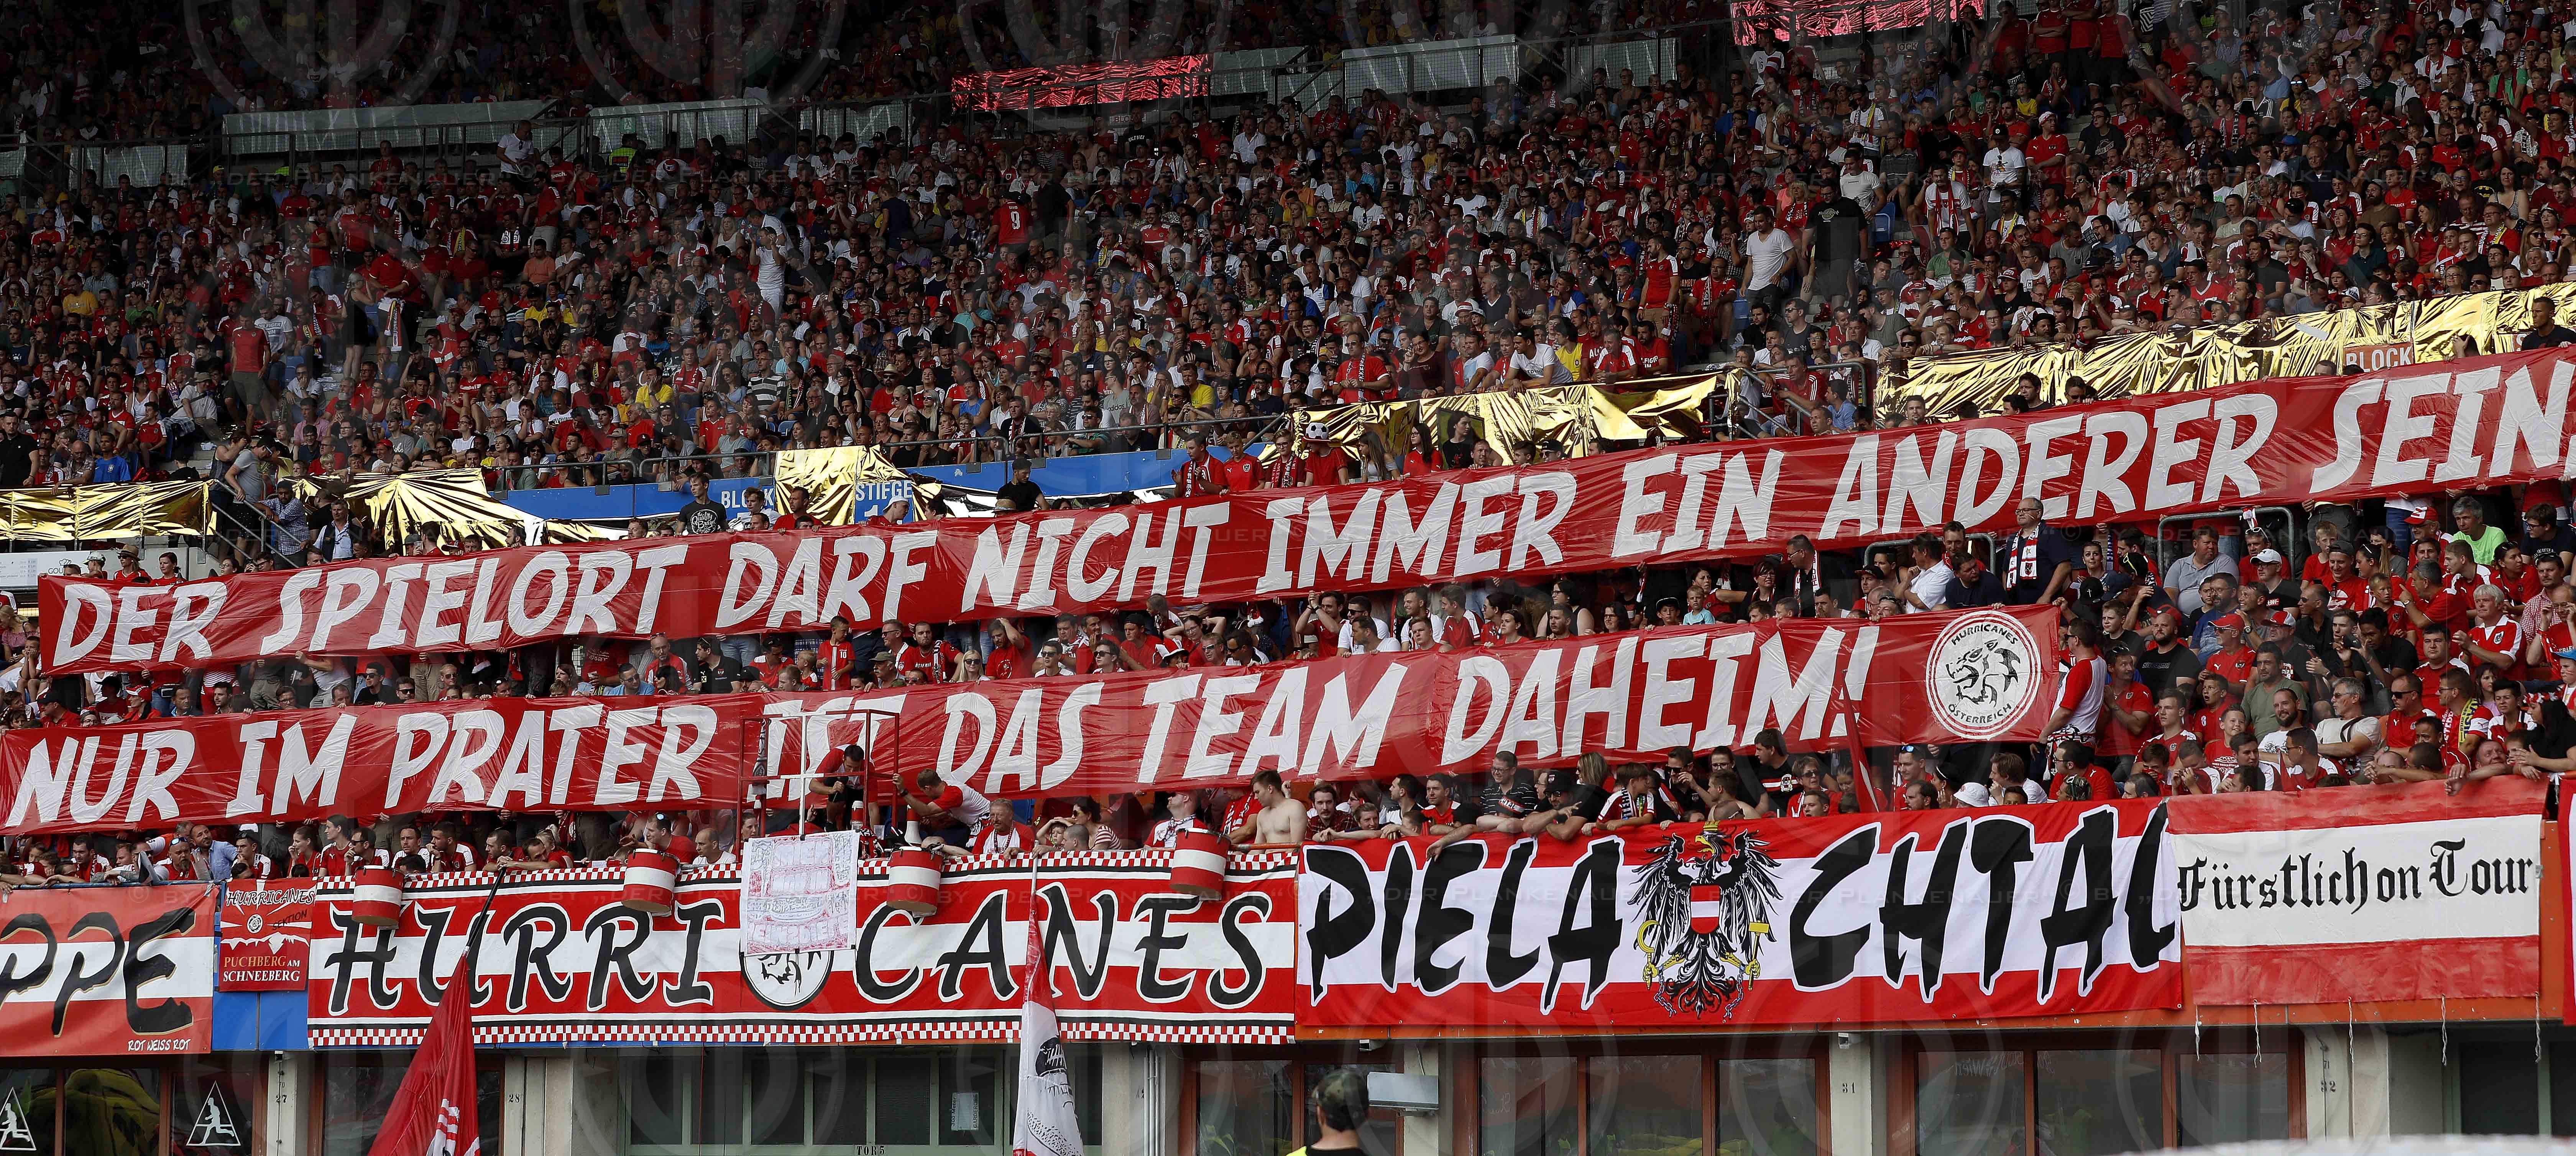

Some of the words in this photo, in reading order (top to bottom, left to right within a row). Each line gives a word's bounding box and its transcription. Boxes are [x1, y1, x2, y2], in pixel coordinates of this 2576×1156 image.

[1010, 212, 1020, 230] 9
[2346, 346, 2412, 373] BLOCK
[721, 488, 772, 508] BLOK
[856, 481, 912, 501] STIEGE
[691, 512, 713, 525] Quality
[697, 519, 716, 530] Brand
[53, 582, 227, 667] DER
[260, 545, 688, 655] SPIELORT
[715, 530, 938, 629] DARF
[961, 501, 1230, 612] NICHT
[1255, 471, 1577, 594] IMMER
[1611, 448, 1785, 558] EIN
[1818, 393, 2279, 540] ANDERER
[1952, 624, 2019, 647] HURRICANES
[1948, 703, 2013, 725] ÖSTERREICH
[2201, 715, 2207, 726] 8
[6, 730, 195, 827] NUR
[226, 713, 357, 818] IM
[384, 704, 718, 810] PRATER
[746, 694, 907, 803] IST
[935, 681, 1105, 795] DAS
[1137, 662, 1408, 784] TEAM
[1441, 626, 1880, 766] DAHEIM!
[2177, 846, 2368, 915] Fürstlich
[2376, 865, 2422, 903] on
[2429, 837, 2533, 897] Tour
[227, 889, 315, 906] HURRICANES
[272, 909, 308, 931] SEKTION
[223, 955, 286, 968] PUCHBERG
[287, 959, 300, 967] AM
[223, 970, 300, 982] SCHNEEBERG
[128, 1039, 146, 1051] ROT
[147, 1039, 172, 1051] WEISS
[174, 1038, 191, 1051] ROT
[1842, 1082, 1855, 1094] 31
[276, 1094, 287, 1104] 27
[509, 1094, 520, 1103] 28
[857, 1145, 877, 1155] TOR
[880, 1145, 885, 1155] 5
